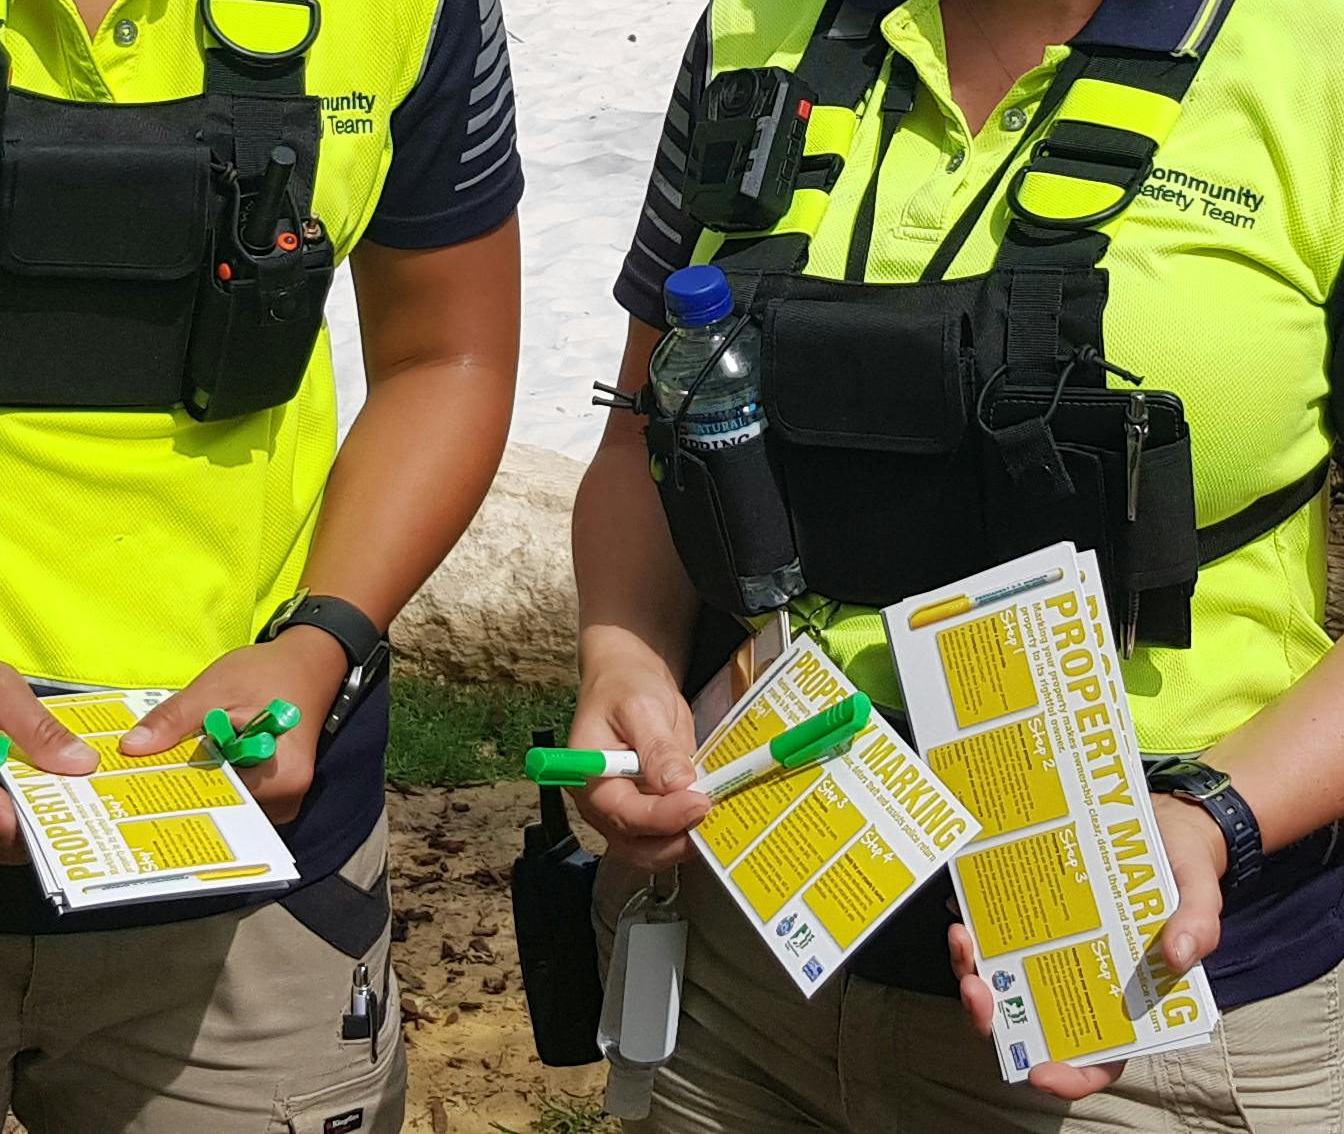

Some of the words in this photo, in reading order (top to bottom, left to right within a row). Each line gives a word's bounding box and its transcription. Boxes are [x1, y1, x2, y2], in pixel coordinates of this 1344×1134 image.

[327, 115, 373, 136] Team
[1138, 183, 1195, 212] afety
[1200, 197, 1256, 230] Team
[1152, 167, 1265, 213] ommunity
[999, 607, 1017, 646] Step
[1019, 606, 1036, 647] property
[1032, 602, 1048, 643] Marking
[1032, 650, 1040, 661] to
[1035, 663, 1044, 676] its
[1041, 645, 1054, 667] your
[1039, 678, 1057, 716] rightful
[1045, 592, 1133, 805] PROPERTY
[1047, 670, 1067, 712] property
[1027, 716, 1046, 755] Step
[1042, 756, 1057, 770] 2
[1062, 715, 1076, 749] makes
[812, 779, 838, 802] Step
[836, 797, 850, 808] 3
[859, 734, 965, 850] MARKING
[1072, 751, 1093, 806] ownership
[18, 782, 105, 881] PROPERTY
[858, 830, 882, 858] Step
[883, 847, 898, 862] 4
[1059, 828, 1078, 866] Step
[1075, 868, 1089, 882] 3
[1097, 838, 1112, 871] deters
[1115, 901, 1129, 921] and
[1122, 924, 1141, 961] assists
[1091, 938, 1111, 979] Step
[1110, 980, 1124, 996] 4
[1144, 997, 1161, 1032] return
